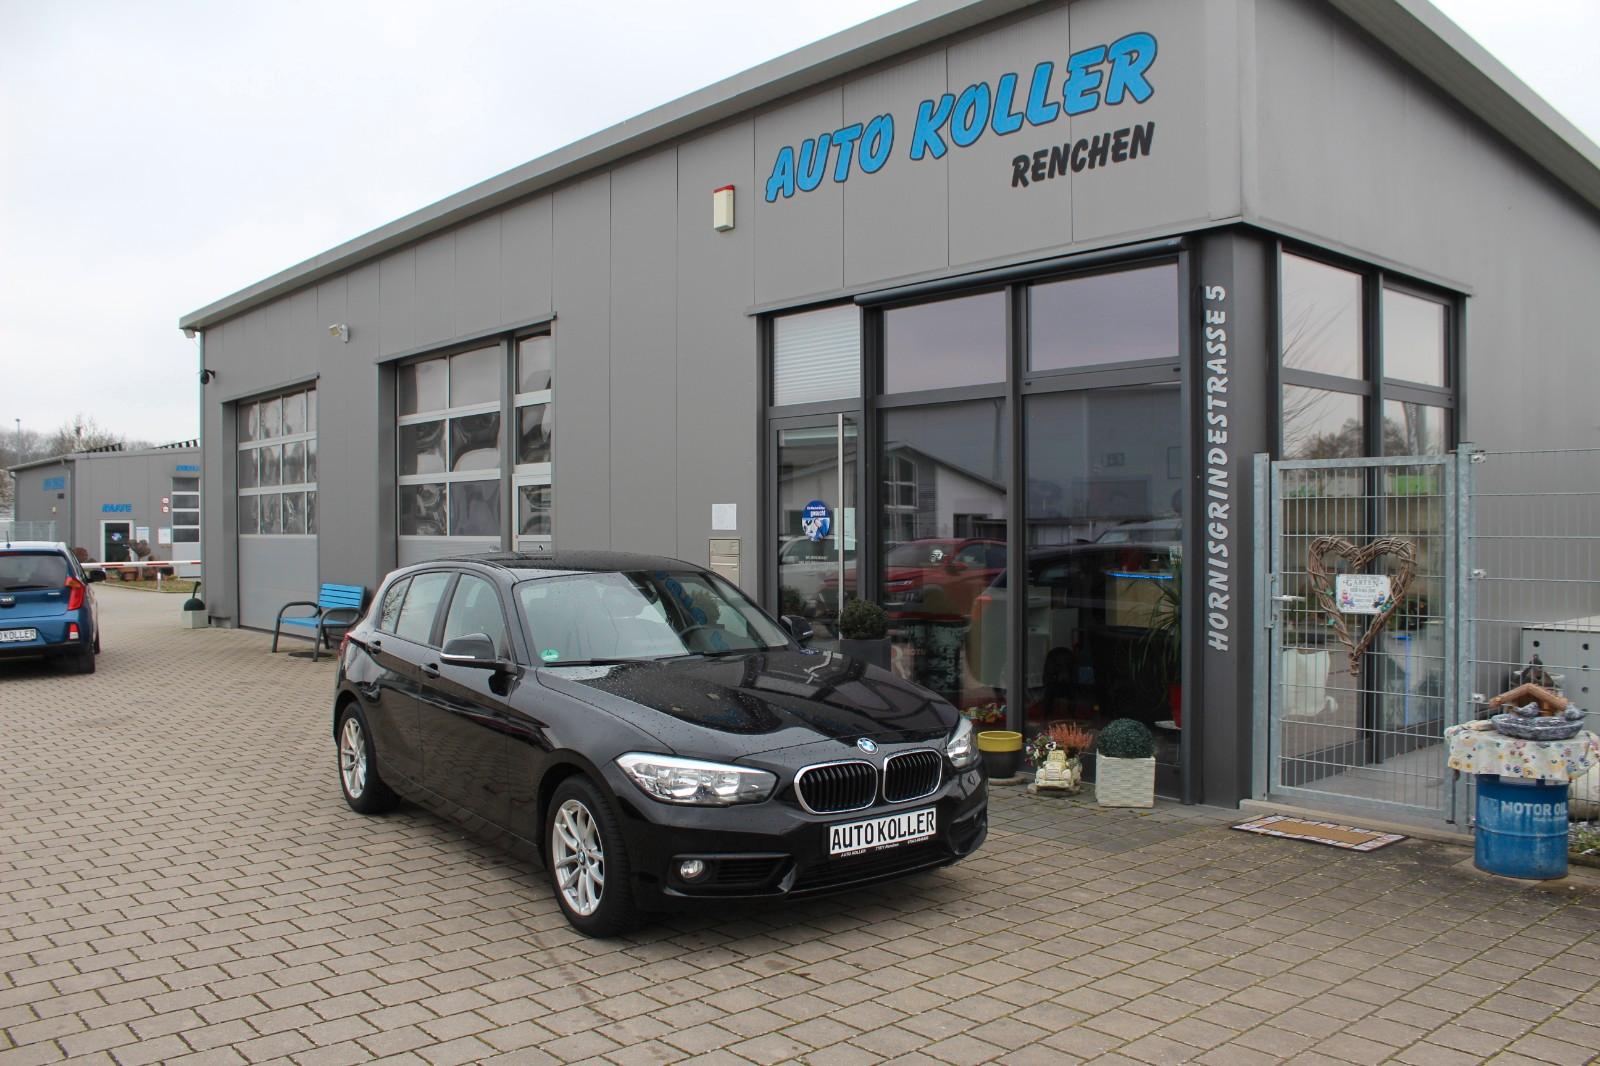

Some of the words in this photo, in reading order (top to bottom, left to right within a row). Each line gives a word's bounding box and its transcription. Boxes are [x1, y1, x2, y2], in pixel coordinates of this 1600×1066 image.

[765, 113, 895, 203] AUTO
[909, 31, 1158, 161] KOLLER
[1011, 121, 1156, 188] RENCHEN
[1205, 286, 1226, 302] 5
[1205, 309, 1230, 652] HORNISGRINDESTRASSE
[832, 823, 874, 851] AUTO
[877, 811, 935, 843] KOLLER
[1501, 800, 1552, 816] MOTOR
[1554, 801, 1568, 815] OIL
